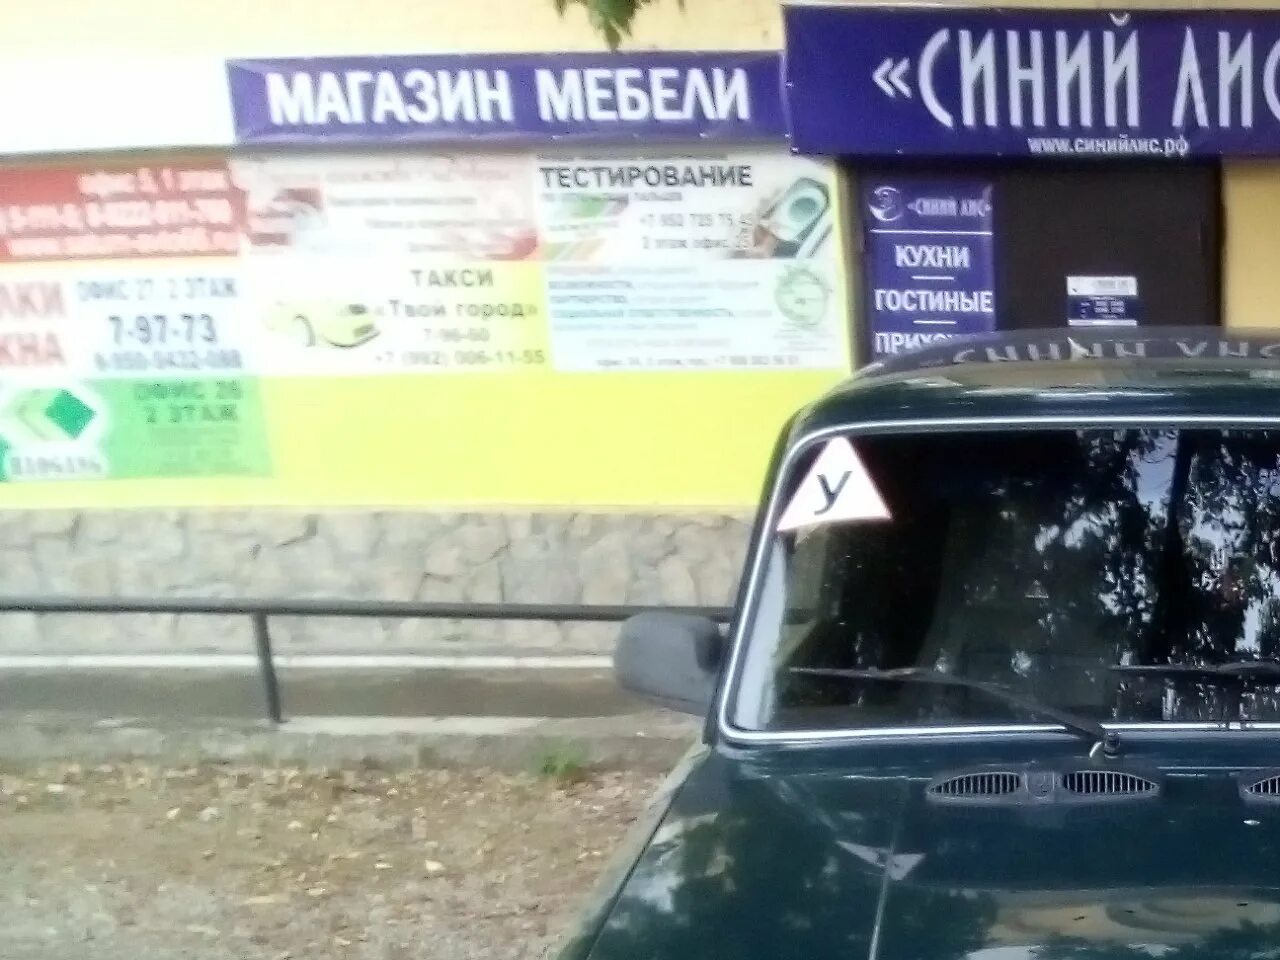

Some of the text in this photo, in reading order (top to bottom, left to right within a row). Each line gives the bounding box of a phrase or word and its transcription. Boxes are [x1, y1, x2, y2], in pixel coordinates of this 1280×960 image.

[872, 12, 1140, 129] «СИНИЙ
[265, 66, 751, 125] МАГАЗИН МЕБЕЛИ
[1028, 133, 1190, 157] www.синийлис.рф
[539, 164, 753, 188] ТЕСТИРОВАНИЕ
[895, 244, 971, 269] КУХНИ
[410, 268, 494, 288] ТАКСИ
[874, 288, 994, 314] ГОСТИНЫЕ
[107, 312, 218, 346] 7-97-73
[813, 470, 854, 516] У
